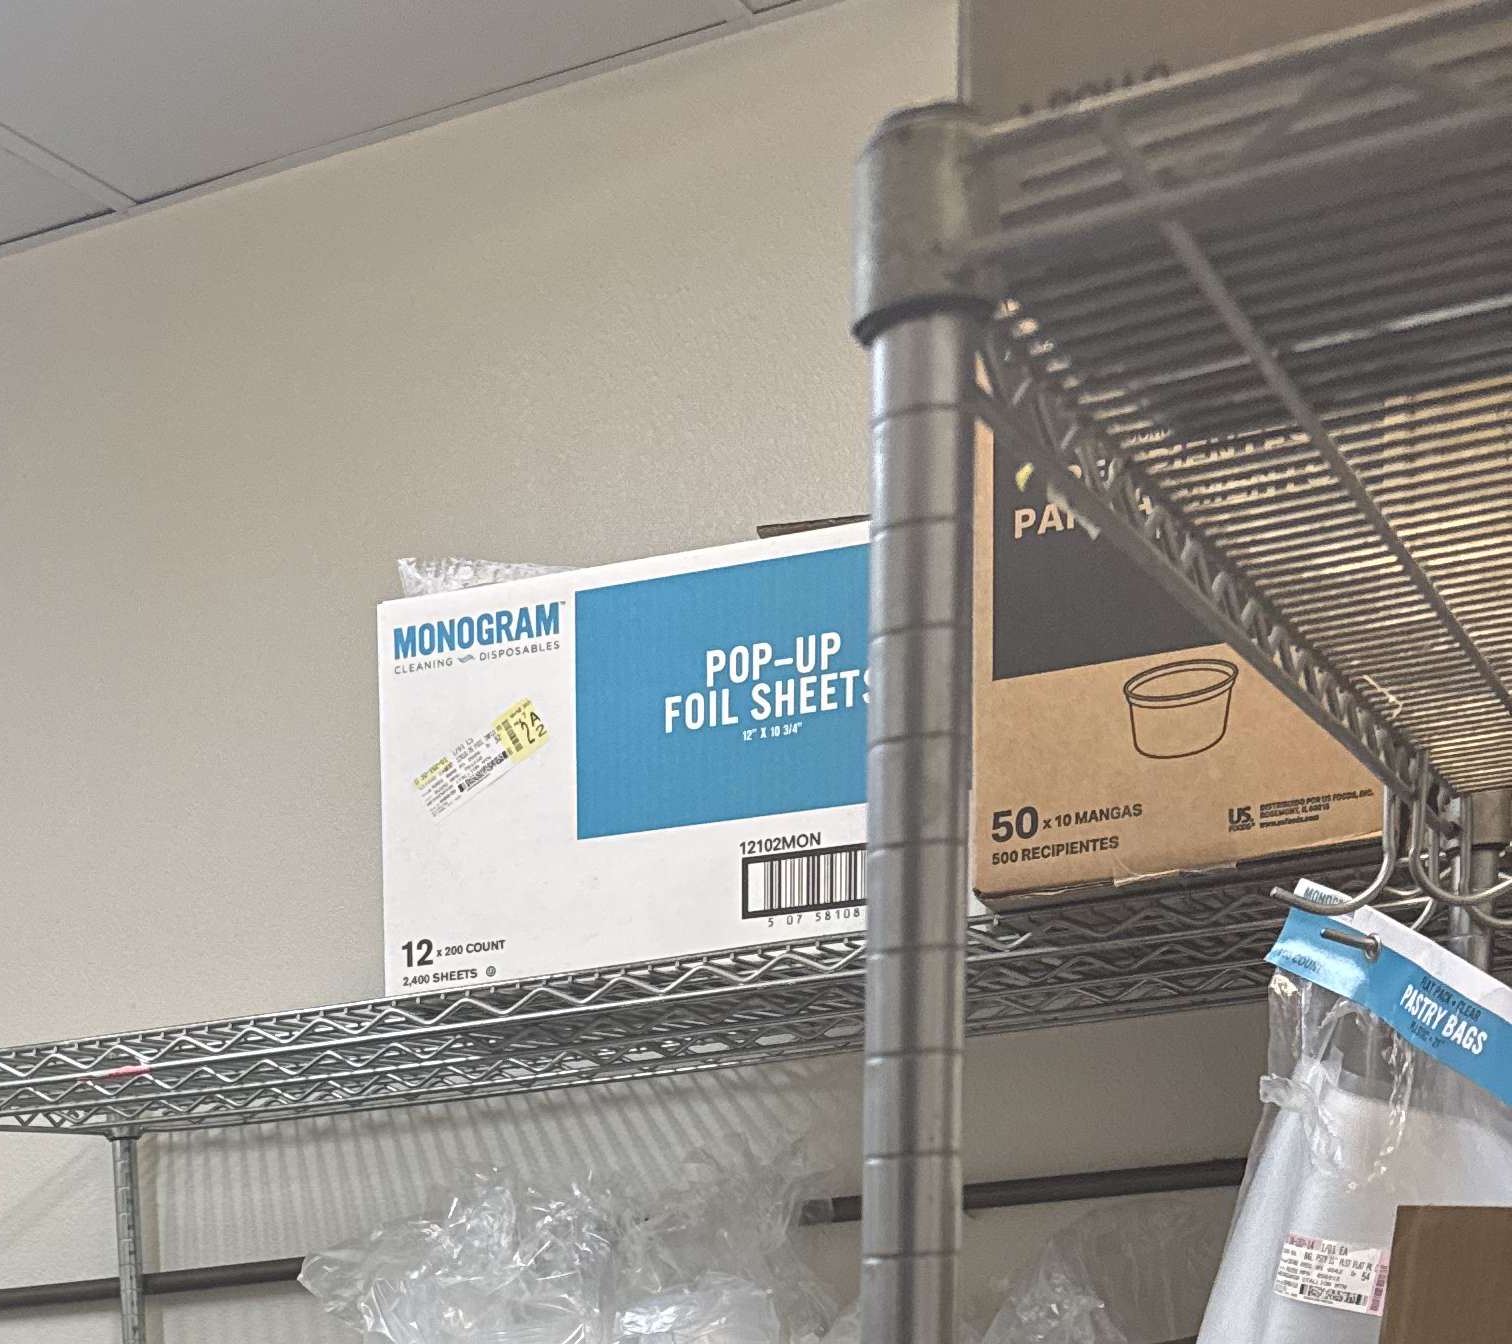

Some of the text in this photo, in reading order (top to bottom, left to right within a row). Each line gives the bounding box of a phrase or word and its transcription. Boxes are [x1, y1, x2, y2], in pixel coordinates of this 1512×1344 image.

[394, 602, 561, 660] MONOGRAM
[394, 640, 561, 675] CLEANING DISPOSABLES
[705, 632, 842, 688] POP-UP
[664, 693, 739, 734] FOIL
[992, 803, 1143, 842] 50 10 MANGAS
[739, 832, 821, 855] 12102MON
[992, 836, 1120, 866] 500 RECIPIENTES
[401, 939, 506, 968] 12 200 COUNT
[402, 968, 478, 987] 2,400 SHEETS
[1400, 984, 1488, 1055] PASTRY BAGS
